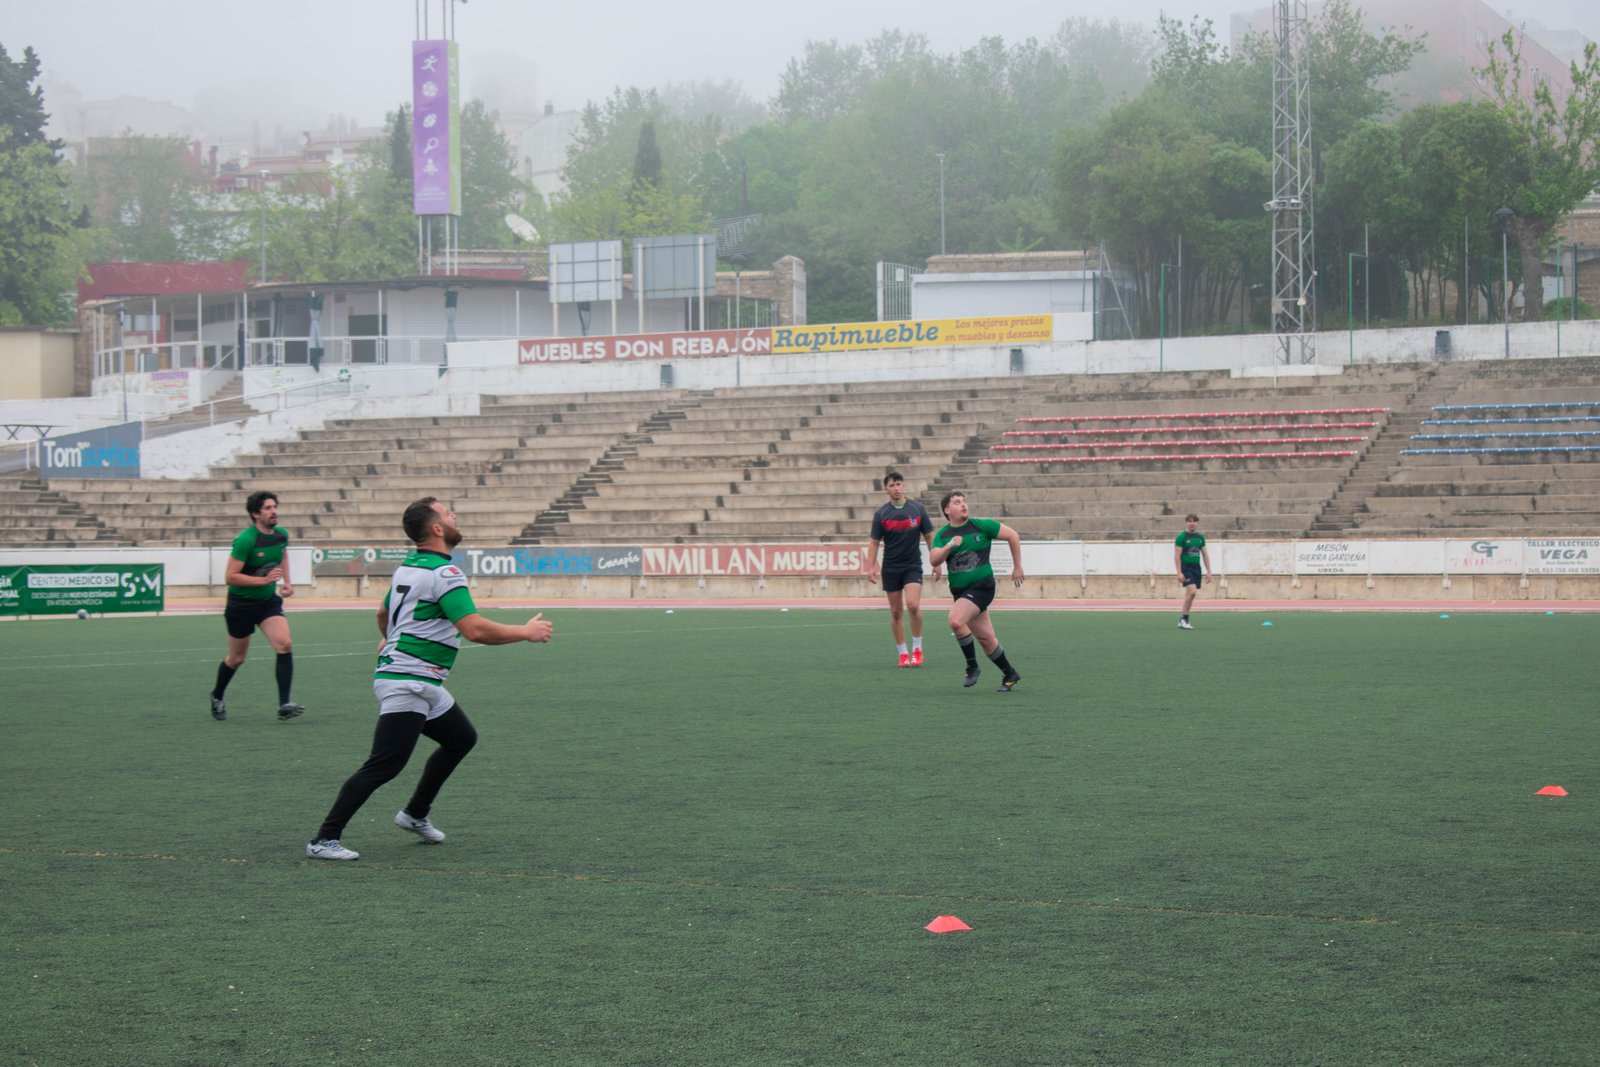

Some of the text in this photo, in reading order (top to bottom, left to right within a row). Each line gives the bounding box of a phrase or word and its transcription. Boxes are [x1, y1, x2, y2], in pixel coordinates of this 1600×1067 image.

[1011, 317, 1044, 328] precios
[773, 323, 939, 350] Rapimueble
[958, 331, 996, 341] muebles
[1006, 330, 1050, 339] descanso
[520, 330, 771, 362] MUEBLES DON REBAJÓN
[598, 552, 640, 570] Canapés
[667, 548, 765, 575] MILLAN
[773, 551, 861, 571] MUEBLES
[1298, 553, 1327, 561] SIERRA
[1540, 549, 1588, 559] VEGA
[31, 576, 66, 586] CENTRO
[104, 576, 117, 585] SM
[392, 584, 411, 627] 7
